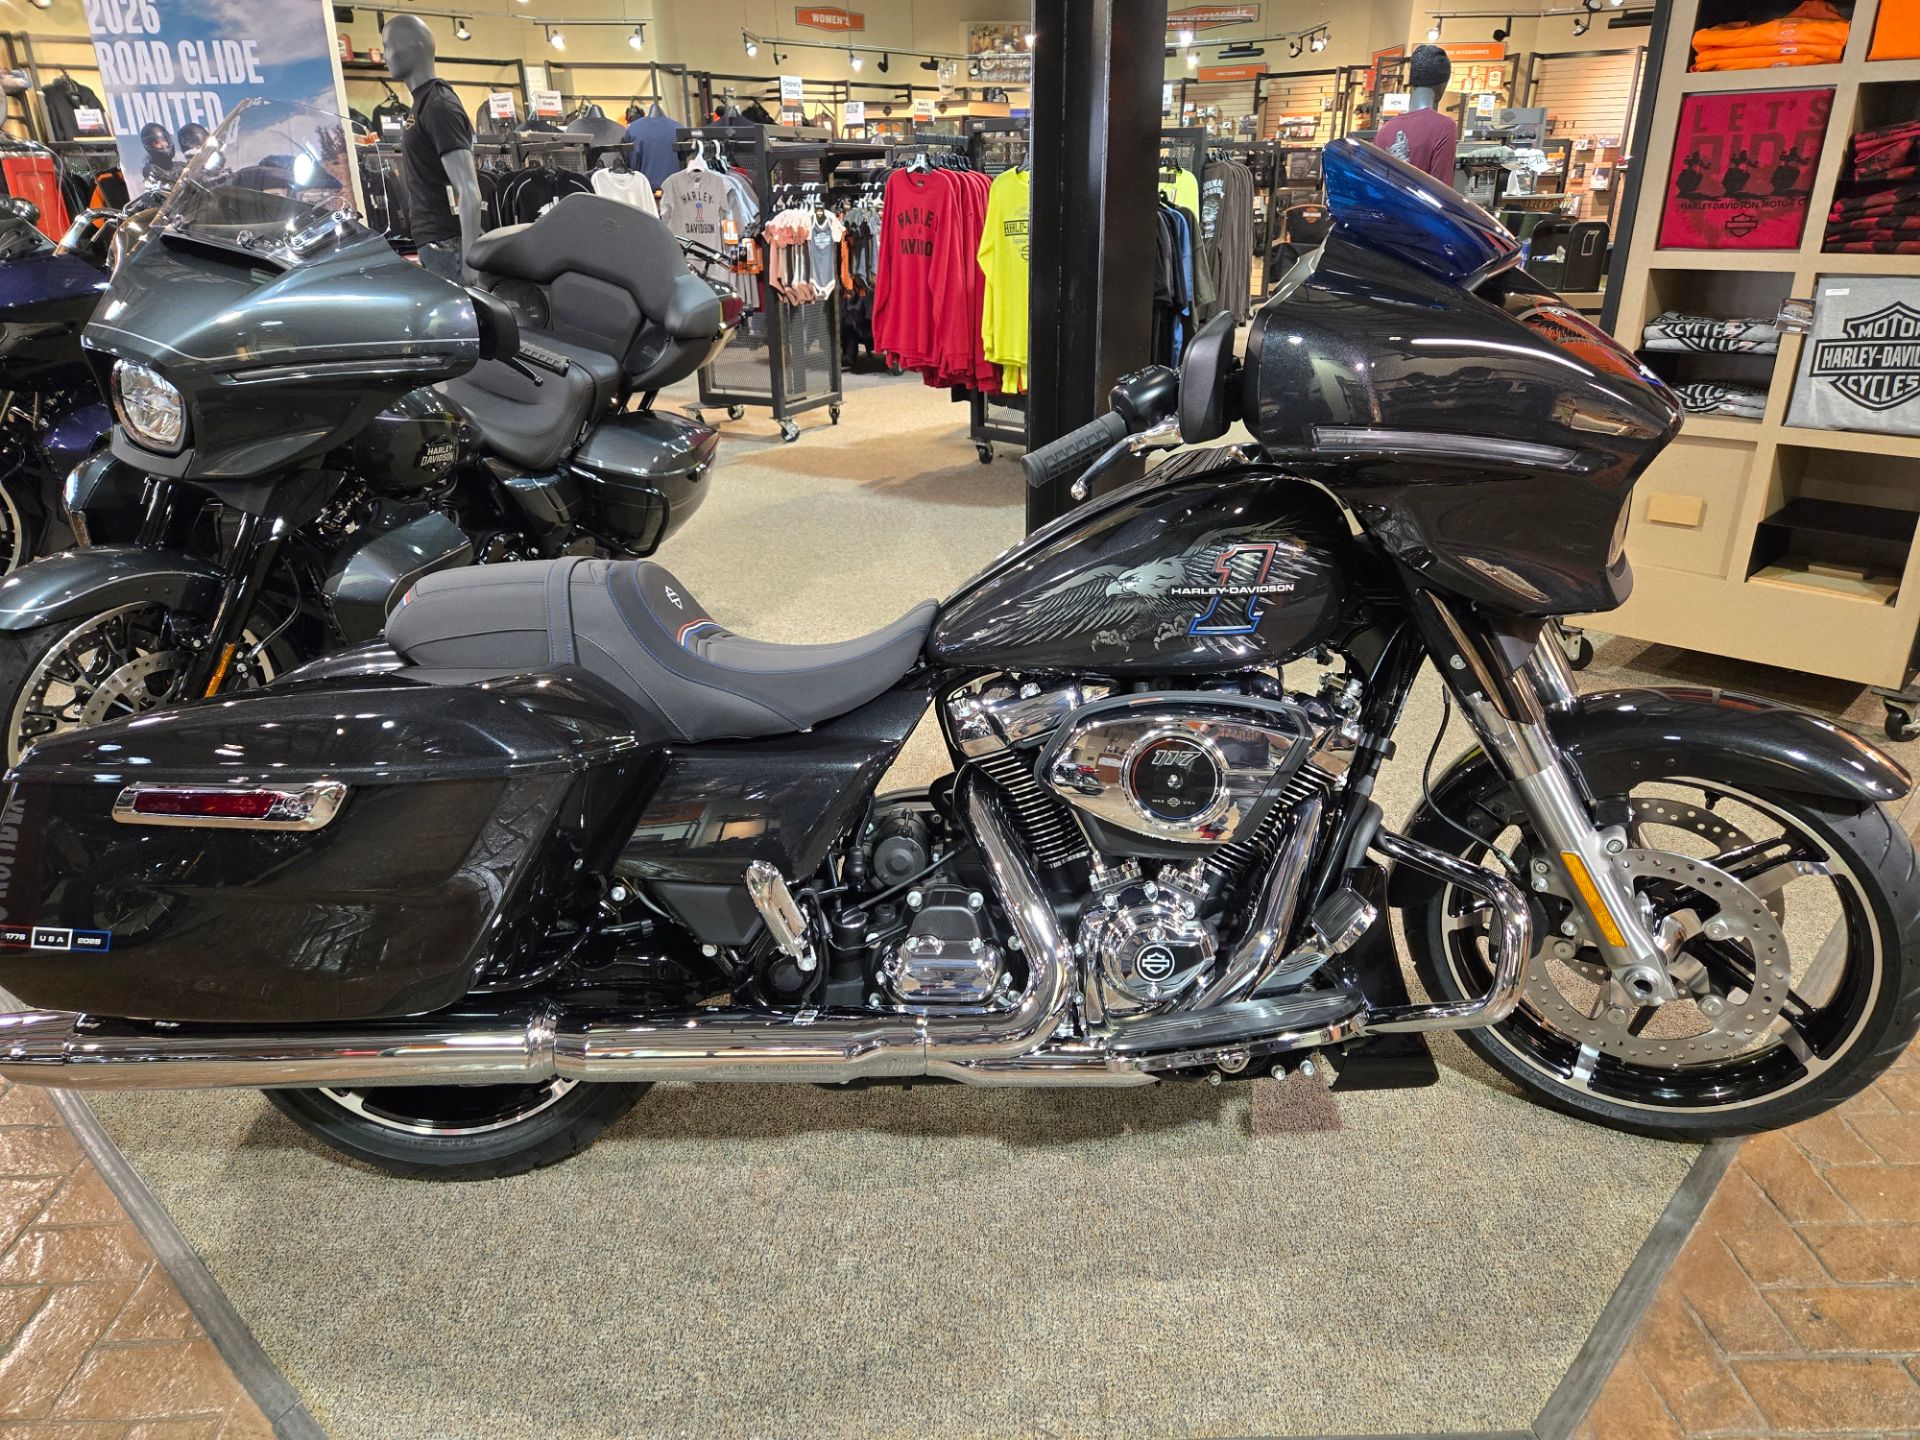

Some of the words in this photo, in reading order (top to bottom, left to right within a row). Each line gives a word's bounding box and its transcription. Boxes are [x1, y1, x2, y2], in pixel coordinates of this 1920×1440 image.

[86, 0, 161, 34] 2026
[811, 13, 850, 26] WOMEN'S
[94, 40, 175, 86] ROAD
[177, 39, 265, 85] GLIDE
[106, 91, 229, 136] LIMITED
[1693, 96, 1830, 132] LET'S
[1847, 375, 1920, 402] CYCLES
[420, 450, 455, 467] DAVIDSON
[427, 444, 453, 456] HARLEY
[1171, 584, 1295, 595] HARLEY-DAVIDSON
[1151, 750, 1202, 766] 117
